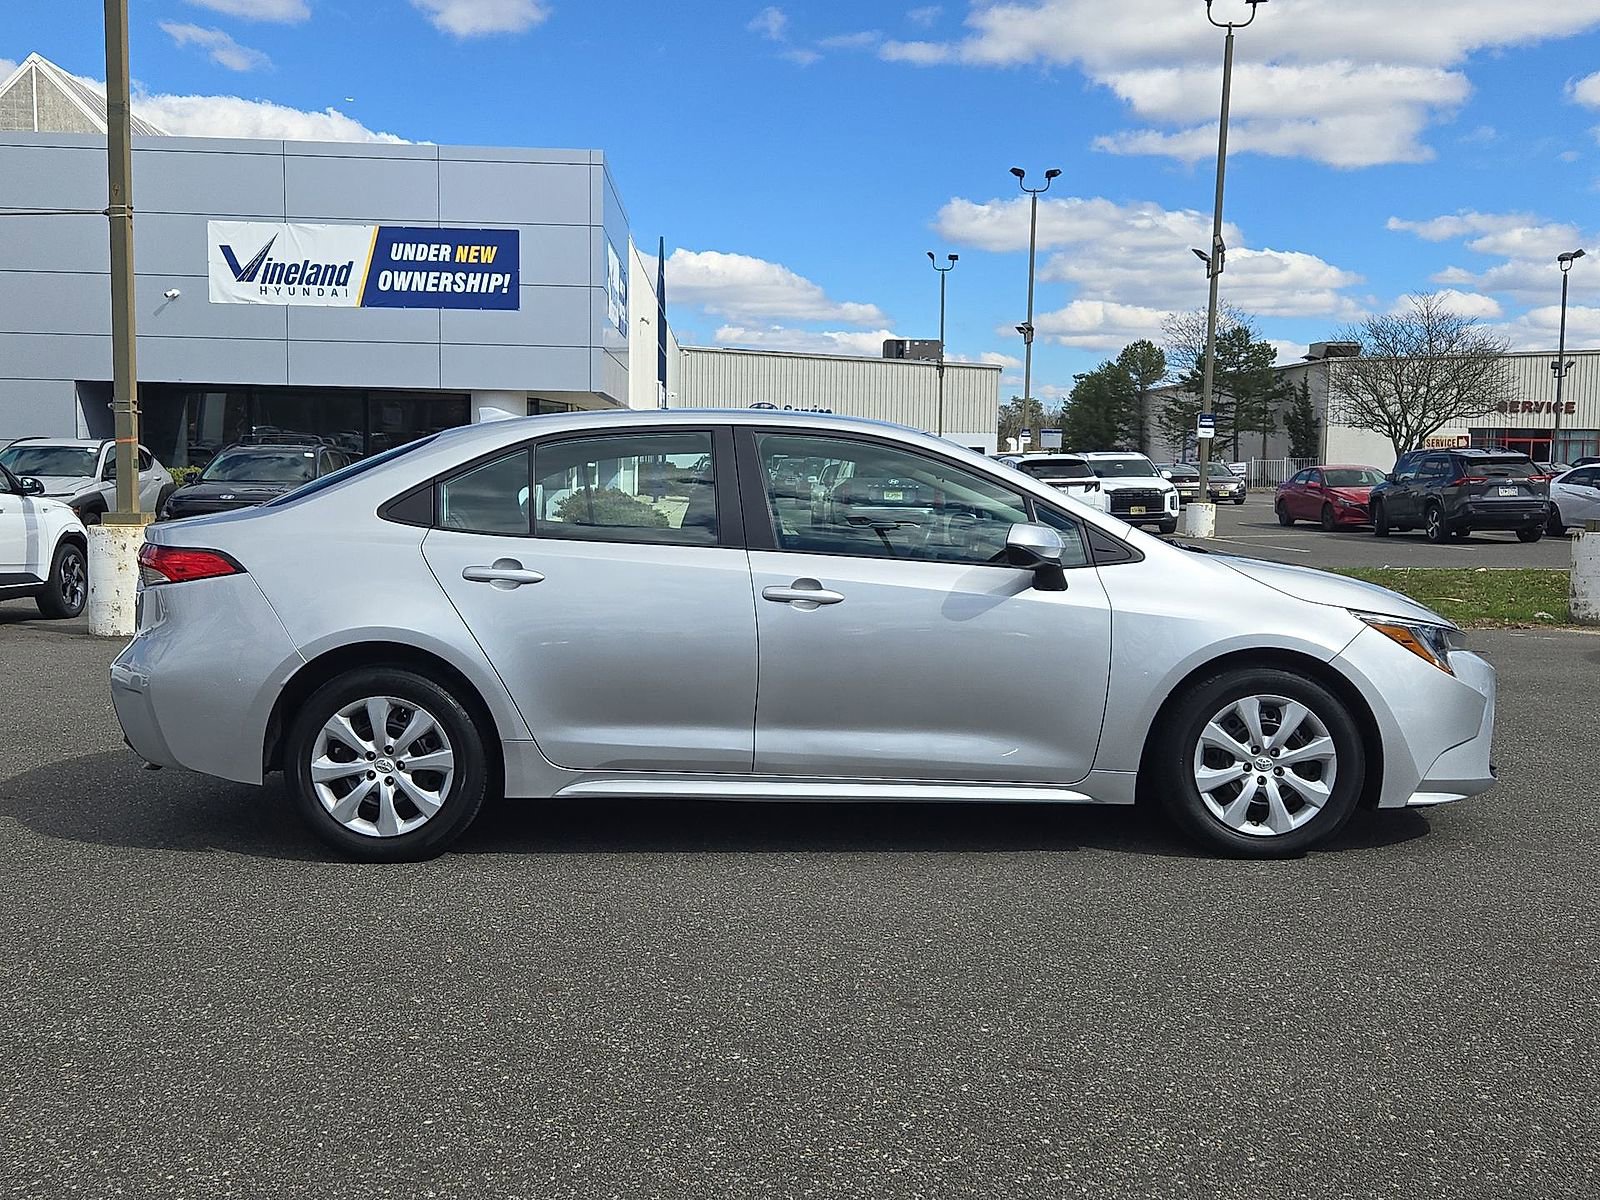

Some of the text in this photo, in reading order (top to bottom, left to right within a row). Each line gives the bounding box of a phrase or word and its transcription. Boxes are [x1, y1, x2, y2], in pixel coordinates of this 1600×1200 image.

[219, 232, 354, 287] Vineland
[390, 243, 498, 264] UNDER NEW
[260, 286, 348, 298] HYUNDAI
[378, 270, 511, 294] OWNERSHIP!
[1425, 438, 1457, 448] SERVICE
